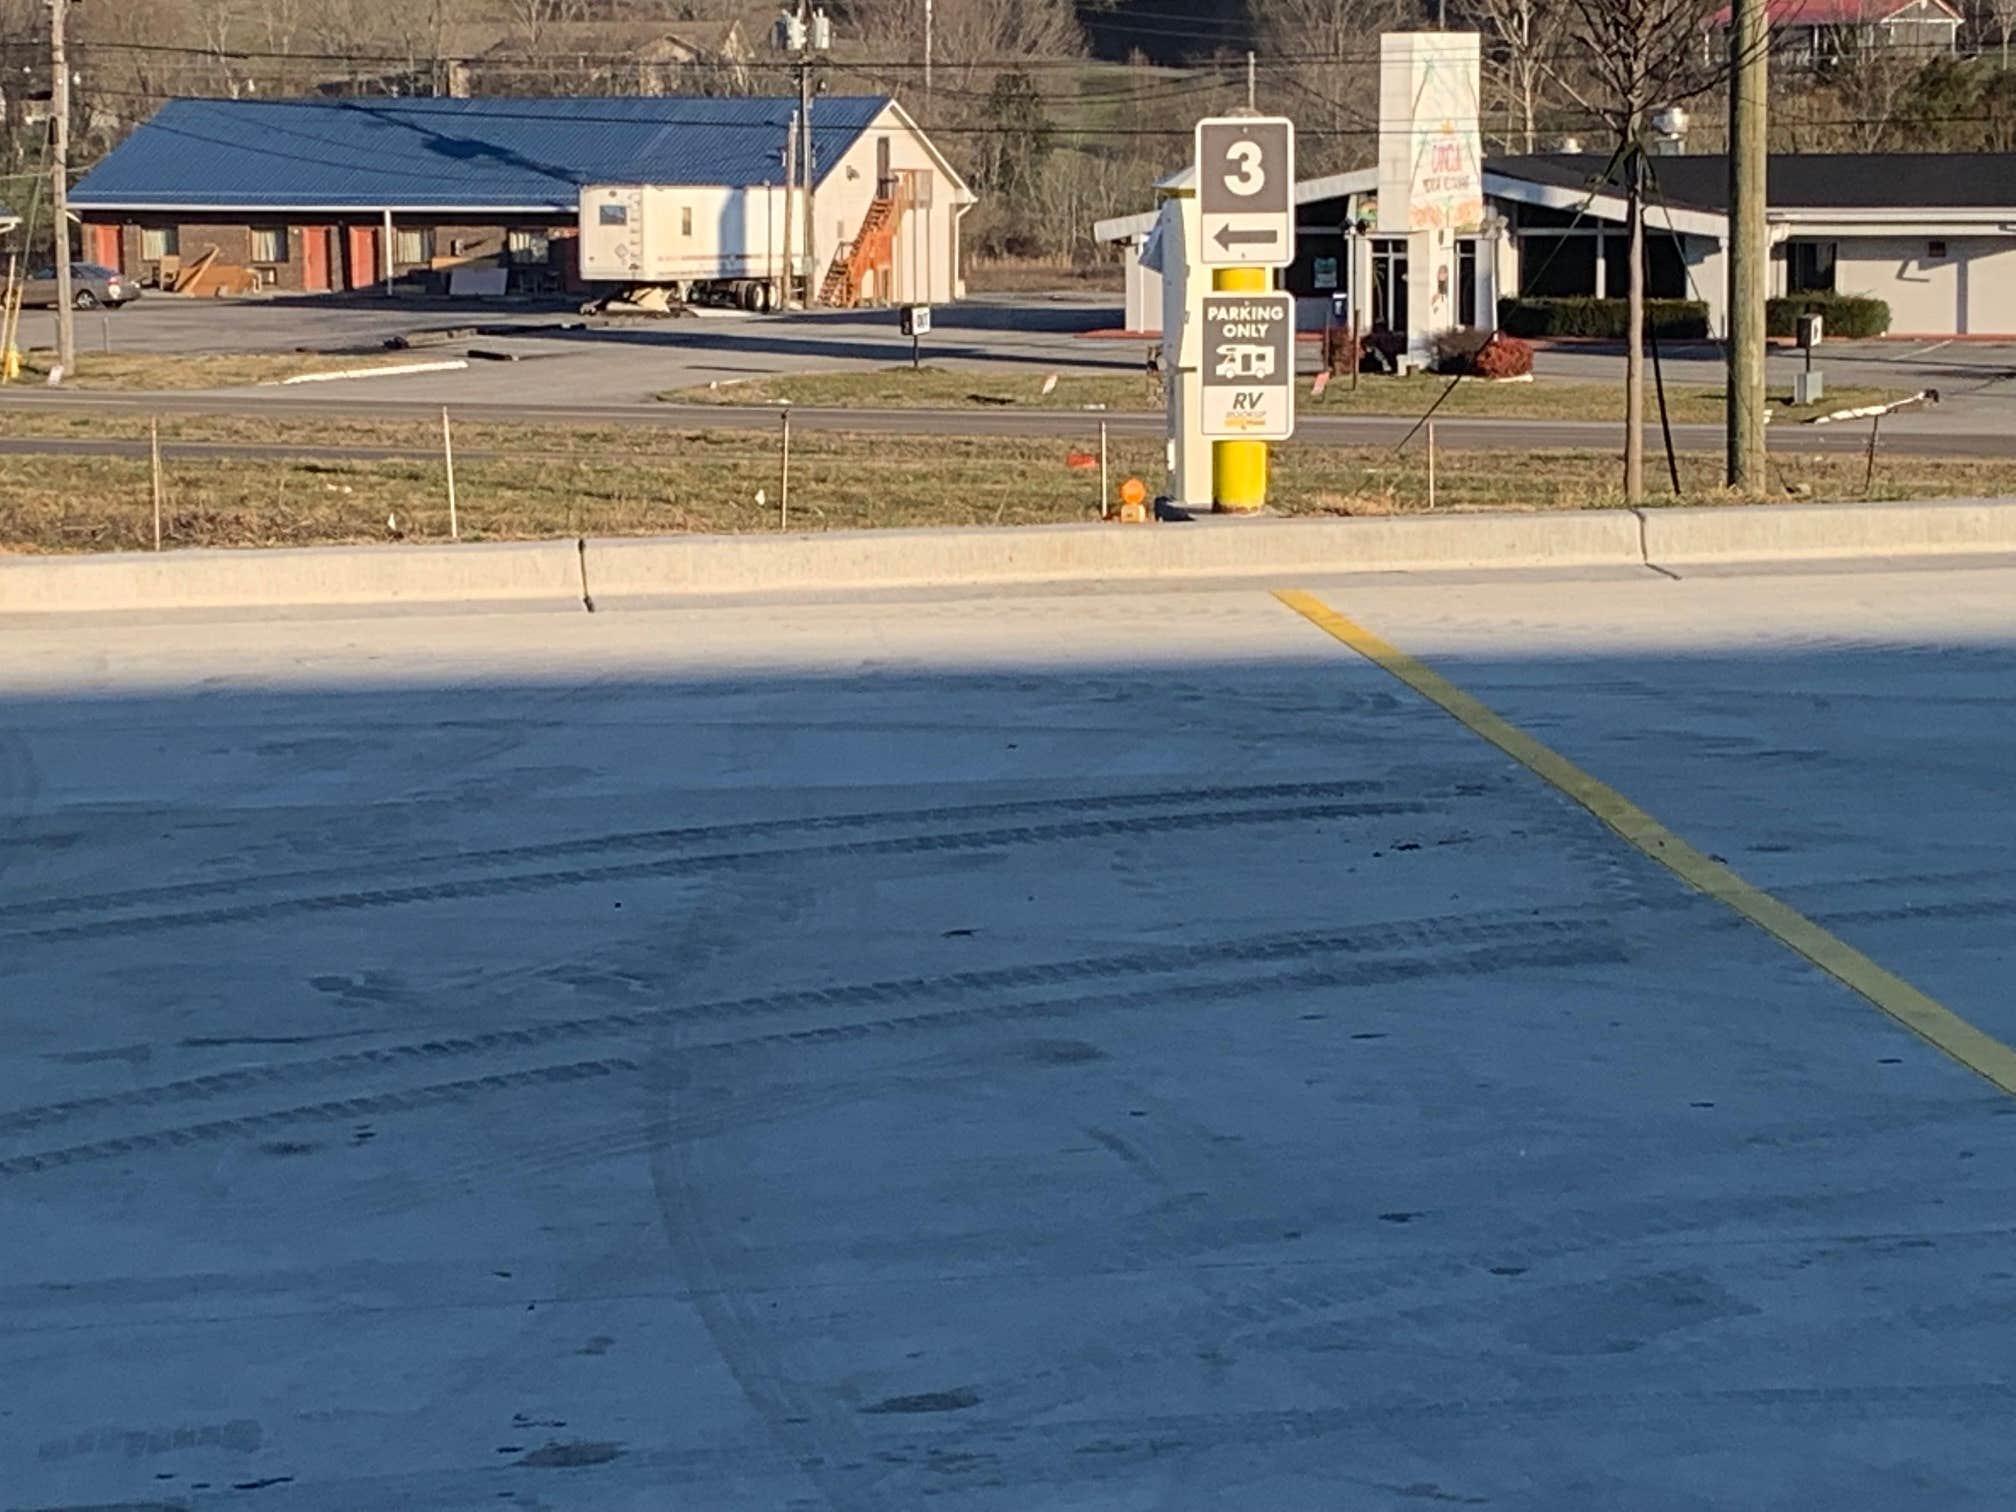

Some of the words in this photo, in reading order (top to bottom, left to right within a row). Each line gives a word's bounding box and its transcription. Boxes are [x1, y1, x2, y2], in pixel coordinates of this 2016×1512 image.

[1224, 141, 1265, 196] 3
[1207, 306, 1284, 321] PARKING
[1222, 323, 1270, 338] ONLY
[1232, 391, 1265, 410] RV
